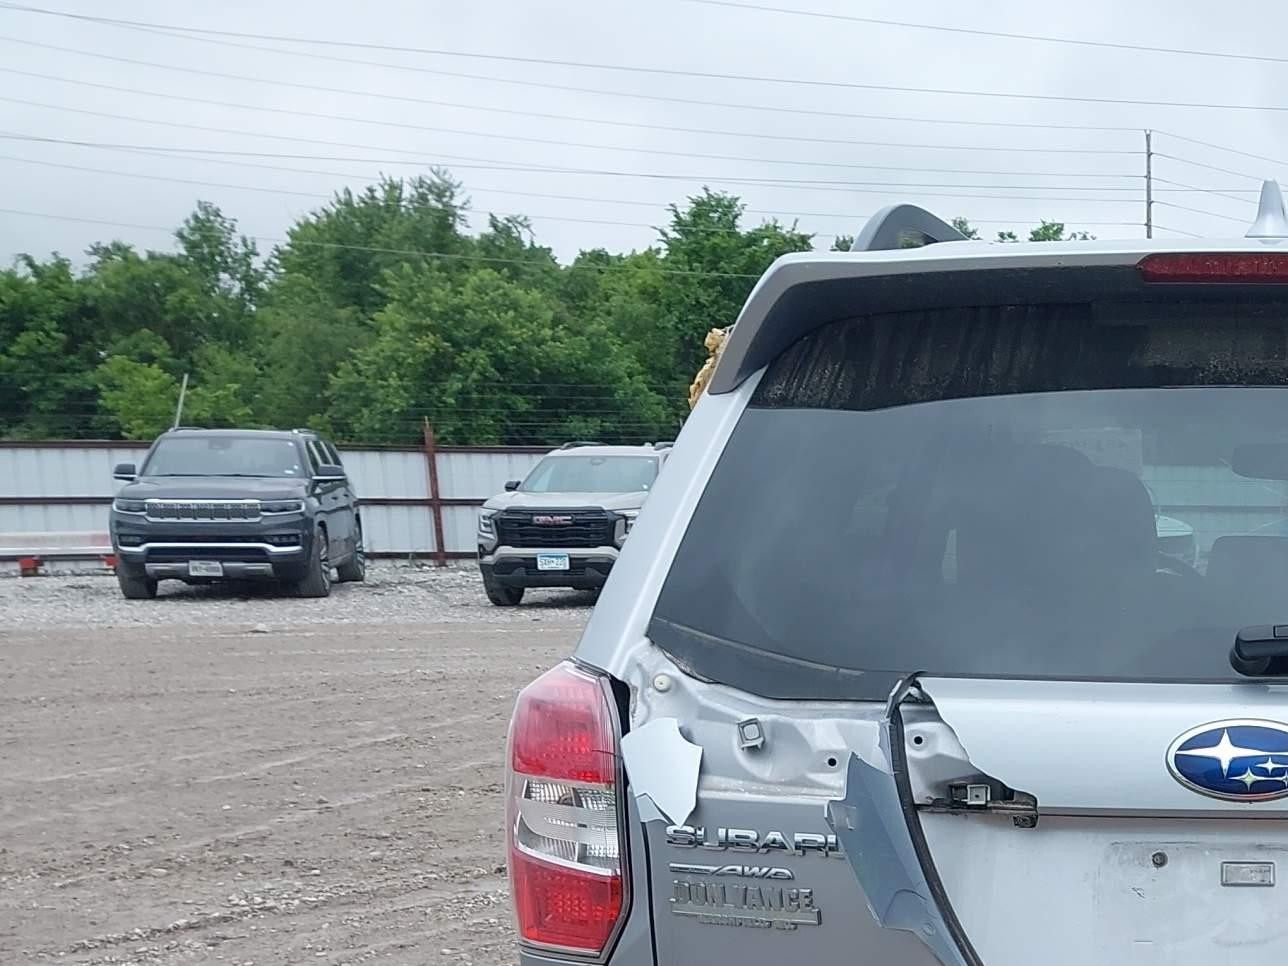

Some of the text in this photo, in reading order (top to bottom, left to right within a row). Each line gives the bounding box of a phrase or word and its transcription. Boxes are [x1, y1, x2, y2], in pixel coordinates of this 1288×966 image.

[532, 515, 573, 525] GMC
[712, 864, 796, 880] AWD
[669, 879, 815, 912] DON VANCE
